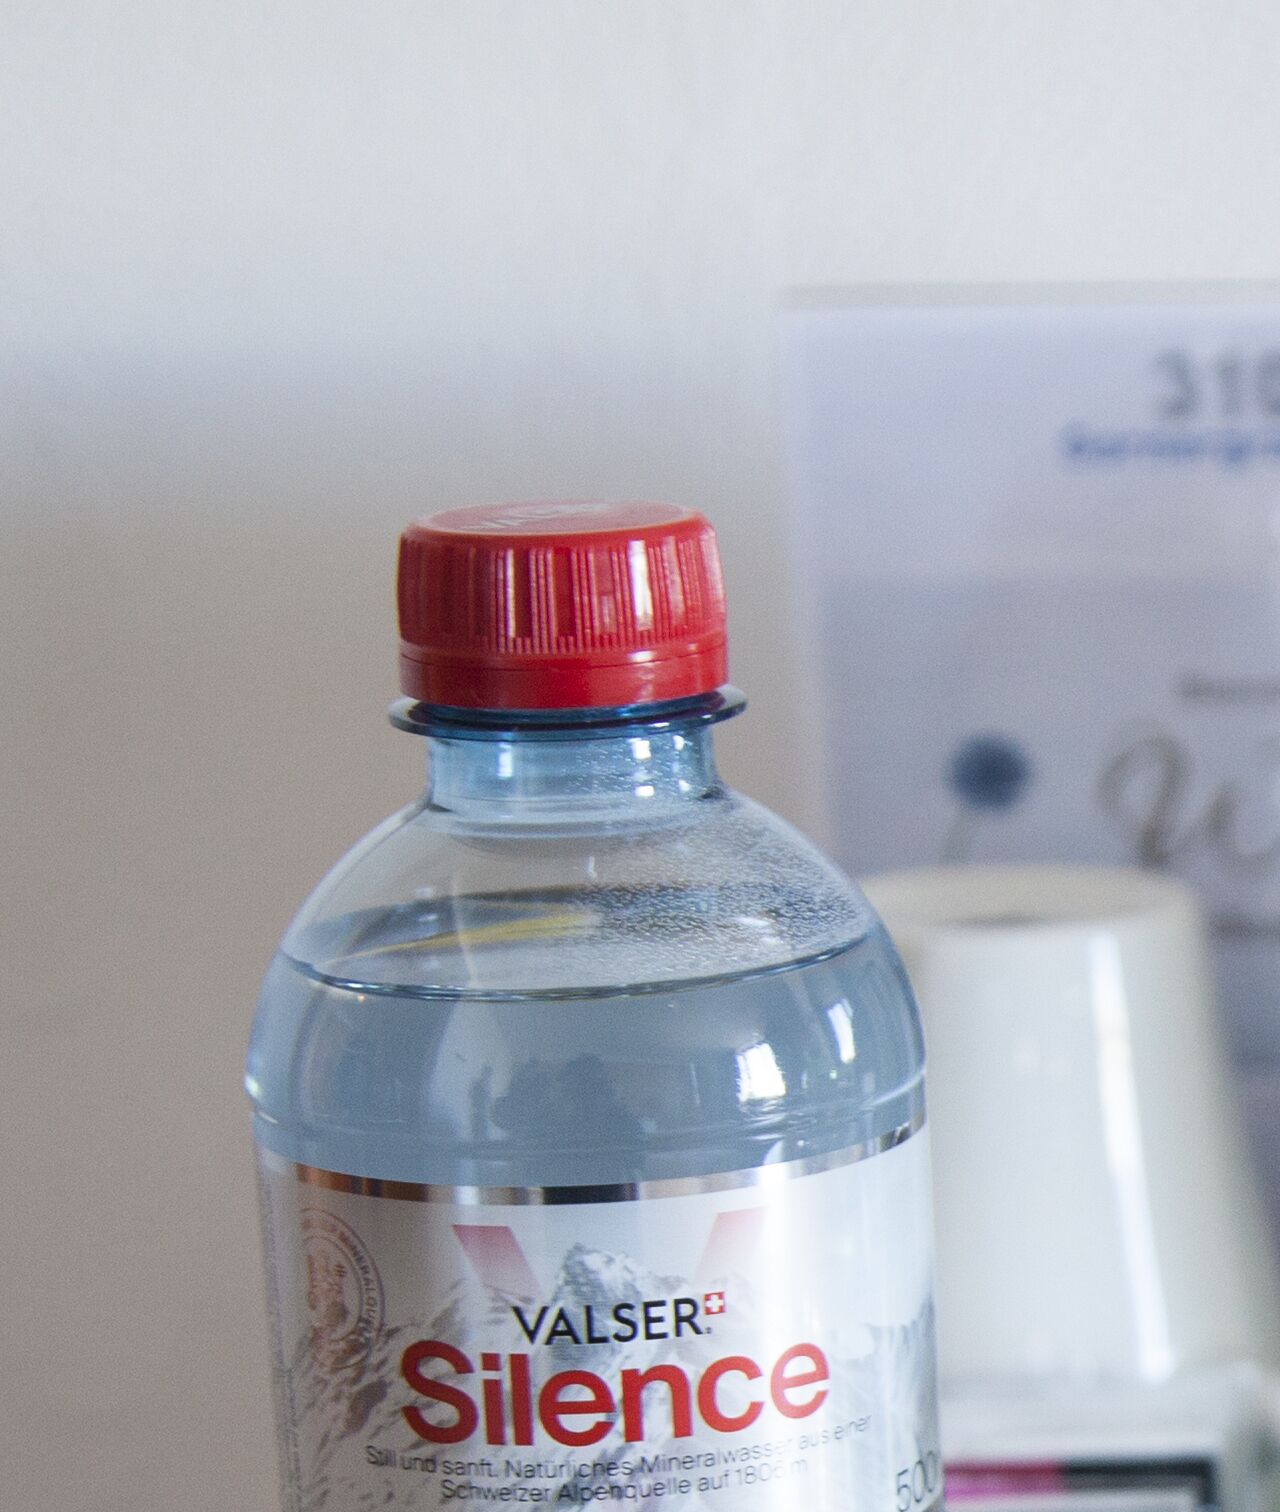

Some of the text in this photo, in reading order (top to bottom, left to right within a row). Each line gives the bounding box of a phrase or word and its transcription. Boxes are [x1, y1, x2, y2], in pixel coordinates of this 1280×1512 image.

[512, 1297, 703, 1345] VALSER
[402, 1339, 831, 1447] Silence
[365, 1413, 873, 1480] Still und sanft. Natürliches Mineralwasser aus einer
[440, 1478, 553, 1503] Schweizer
[557, 1475, 691, 1504] Alpenquelle
[698, 1469, 731, 1493] auf
